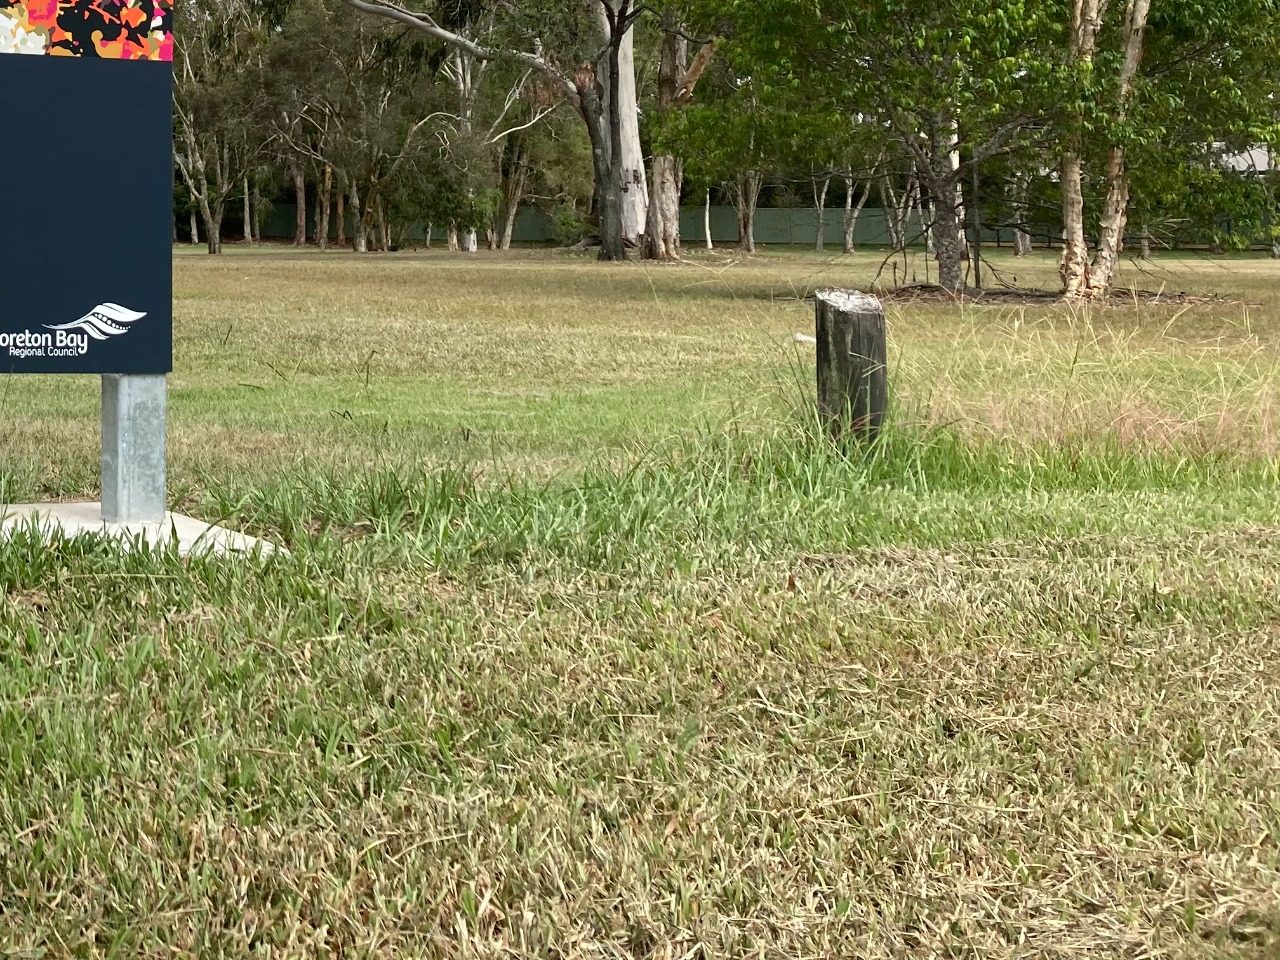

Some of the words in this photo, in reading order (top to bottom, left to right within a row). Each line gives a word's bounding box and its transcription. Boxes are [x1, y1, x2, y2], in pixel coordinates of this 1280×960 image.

[55, 329, 88, 355] Bay
[9, 346, 46, 359] Regional
[47, 346, 79, 357] Council
